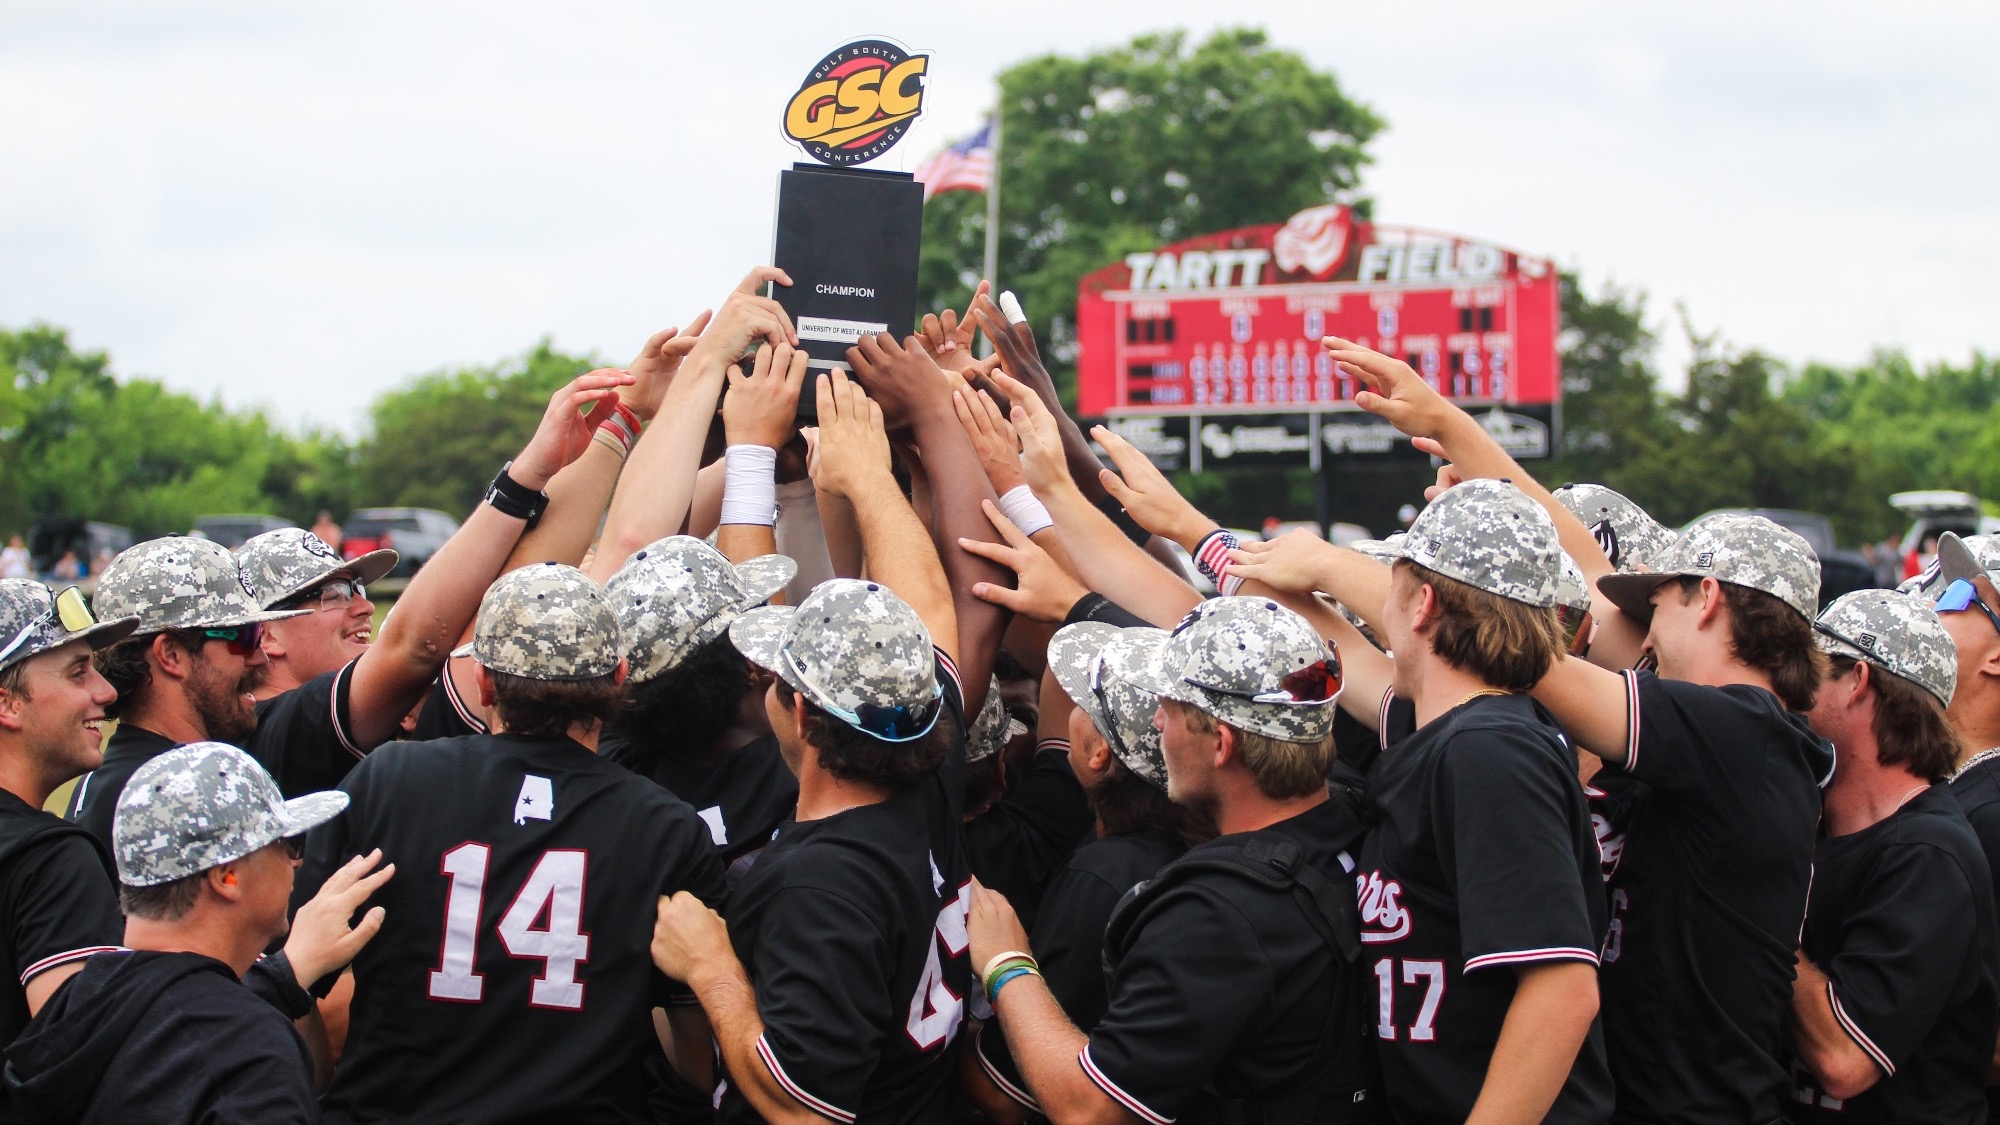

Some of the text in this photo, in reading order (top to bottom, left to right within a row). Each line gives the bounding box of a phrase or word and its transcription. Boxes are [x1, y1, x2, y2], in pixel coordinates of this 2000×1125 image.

[815, 47, 898, 79] GULF SOUTH
[785, 56, 927, 140] GSC
[815, 126, 901, 162] CONFERENCE
[1125, 243, 1502, 291] TARTT FIELD
[815, 284, 875, 298] CHAMPION
[801, 324, 831, 334] UNIVERSITY
[841, 327, 856, 335] WEST
[428, 841, 591, 1011] 14
[1374, 956, 1446, 1041] 17
